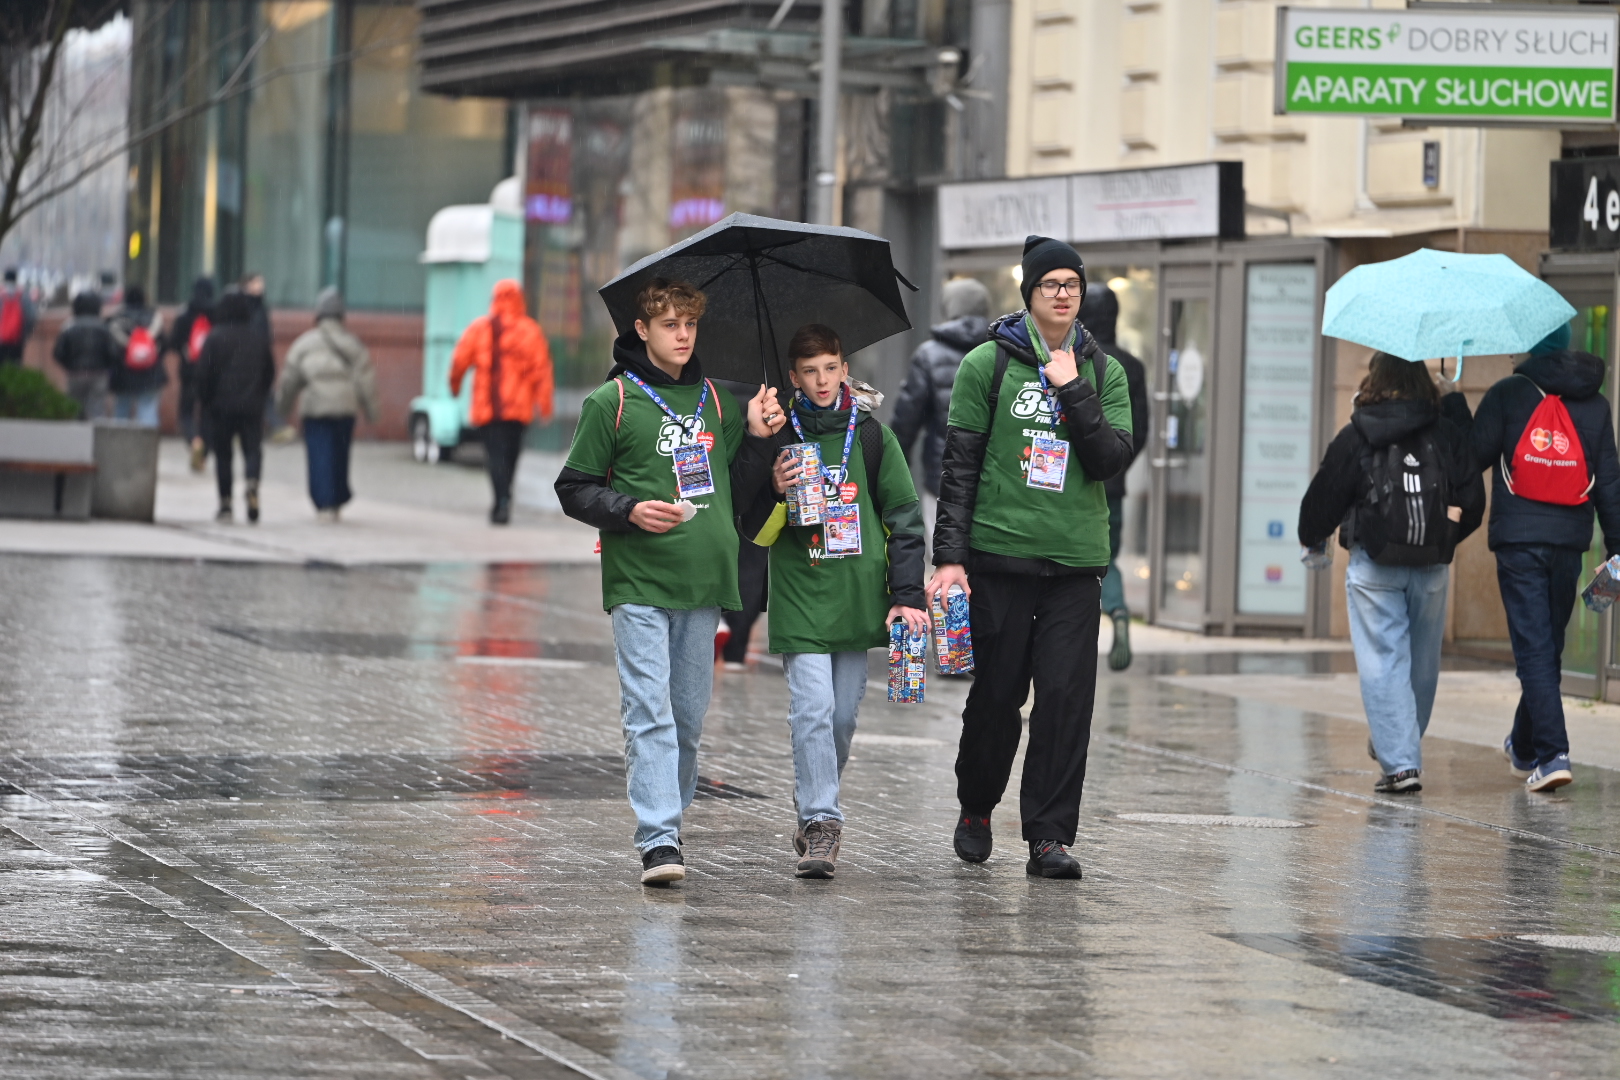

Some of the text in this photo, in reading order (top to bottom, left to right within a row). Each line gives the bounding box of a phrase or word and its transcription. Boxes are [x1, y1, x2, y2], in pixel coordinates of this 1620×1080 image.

[1295, 26, 1608, 55] GEERS DOBRY SŁUCH
[1292, 75, 1608, 108] APARATY SŁUCHOWE
[656, 414, 705, 456] 33
[1524, 453, 1577, 467] Gramy razem
